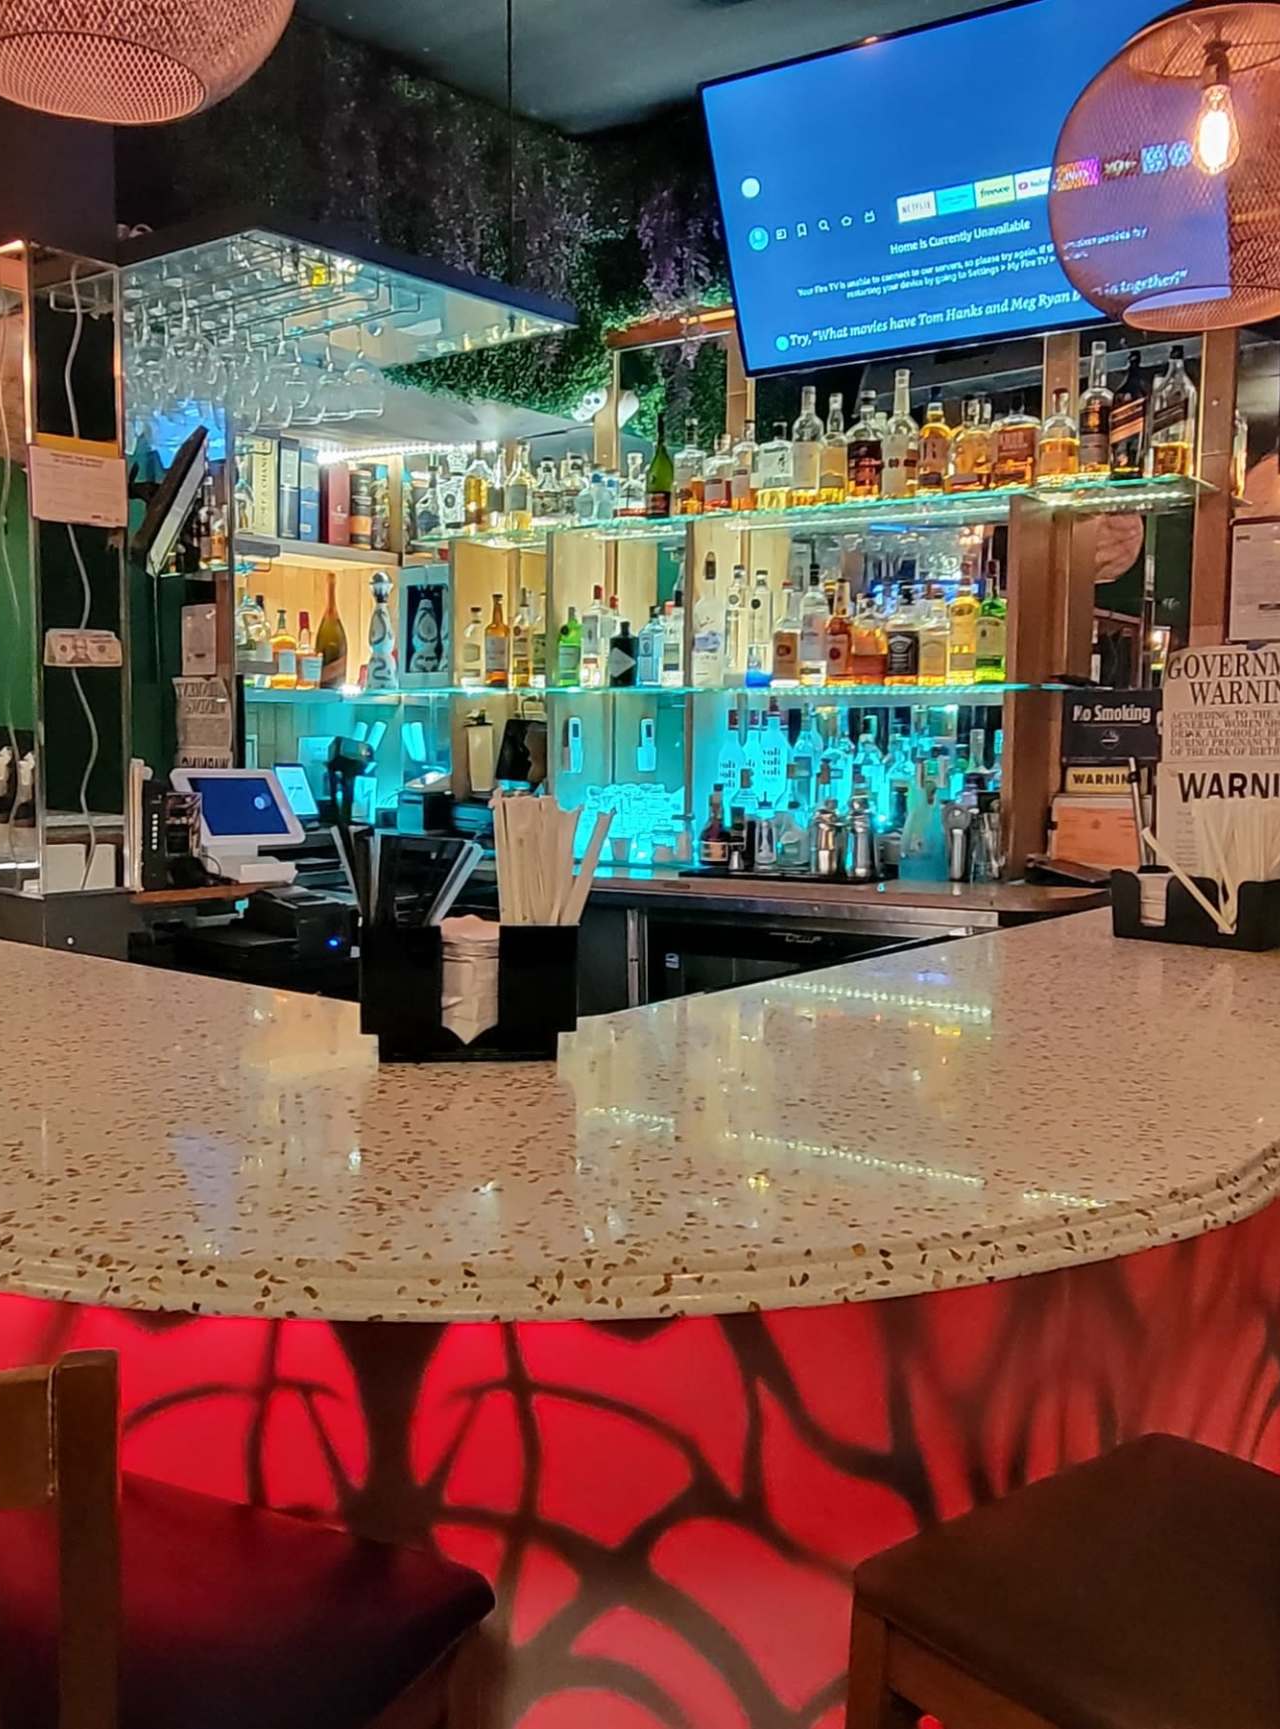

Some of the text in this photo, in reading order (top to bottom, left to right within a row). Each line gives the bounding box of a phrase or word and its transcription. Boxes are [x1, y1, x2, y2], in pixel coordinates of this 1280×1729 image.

[889, 242, 918, 254] Home
[928, 230, 973, 247] Currently
[973, 219, 1031, 239] Unavailable
[797, 287, 813, 297] Your
[814, 284, 828, 294] Fire
[828, 282, 839, 291] TV
[846, 277, 871, 288] unable
[871, 275, 880, 284] to
[881, 271, 910, 283] connect
[911, 268, 919, 277] to
[920, 266, 934, 275] our
[964, 260, 974, 268] so
[974, 254, 1000, 267] please
[1000, 252, 1013, 262] try
[846, 286, 882, 299] restarting
[882, 283, 899, 294] your
[899, 278, 924, 290] device
[923, 276, 934, 287] by
[935, 272, 957, 285] going
[957, 270, 967, 279] to
[967, 265, 1000, 278] Settings
[1007, 261, 1020, 273] My
[1020, 257, 1036, 268] Fire
[1036, 255, 1049, 266] TV
[789, 333, 812, 347] Try,
[849, 320, 888, 337] movies
[889, 316, 917, 331] have
[917, 311, 945, 325] Tom
[945, 304, 984, 321] Hanks
[984, 298, 1009, 315] and
[1009, 296, 1036, 312] Meg
[1037, 290, 1070, 309] Ryan
[1072, 704, 1151, 724] No Smoking
[1172, 710, 1230, 720] ACCORDING
[1235, 710, 1248, 719] TO
[1253, 710, 1271, 719] THE
[1224, 719, 1262, 728] WOMEN
[1207, 728, 1263, 738] ALCOHOLIC
[1170, 738, 1209, 747] DURING
[1211, 738, 1271, 747] PREGNANCY
[1170, 747, 1182, 756] OF
[1186, 747, 1204, 756] THE
[1208, 747, 1231, 756] RISK
[1233, 747, 1246, 756] OF
[1249, 747, 1280, 756] BIRTH
[1072, 773, 1132, 785] WARNIN
